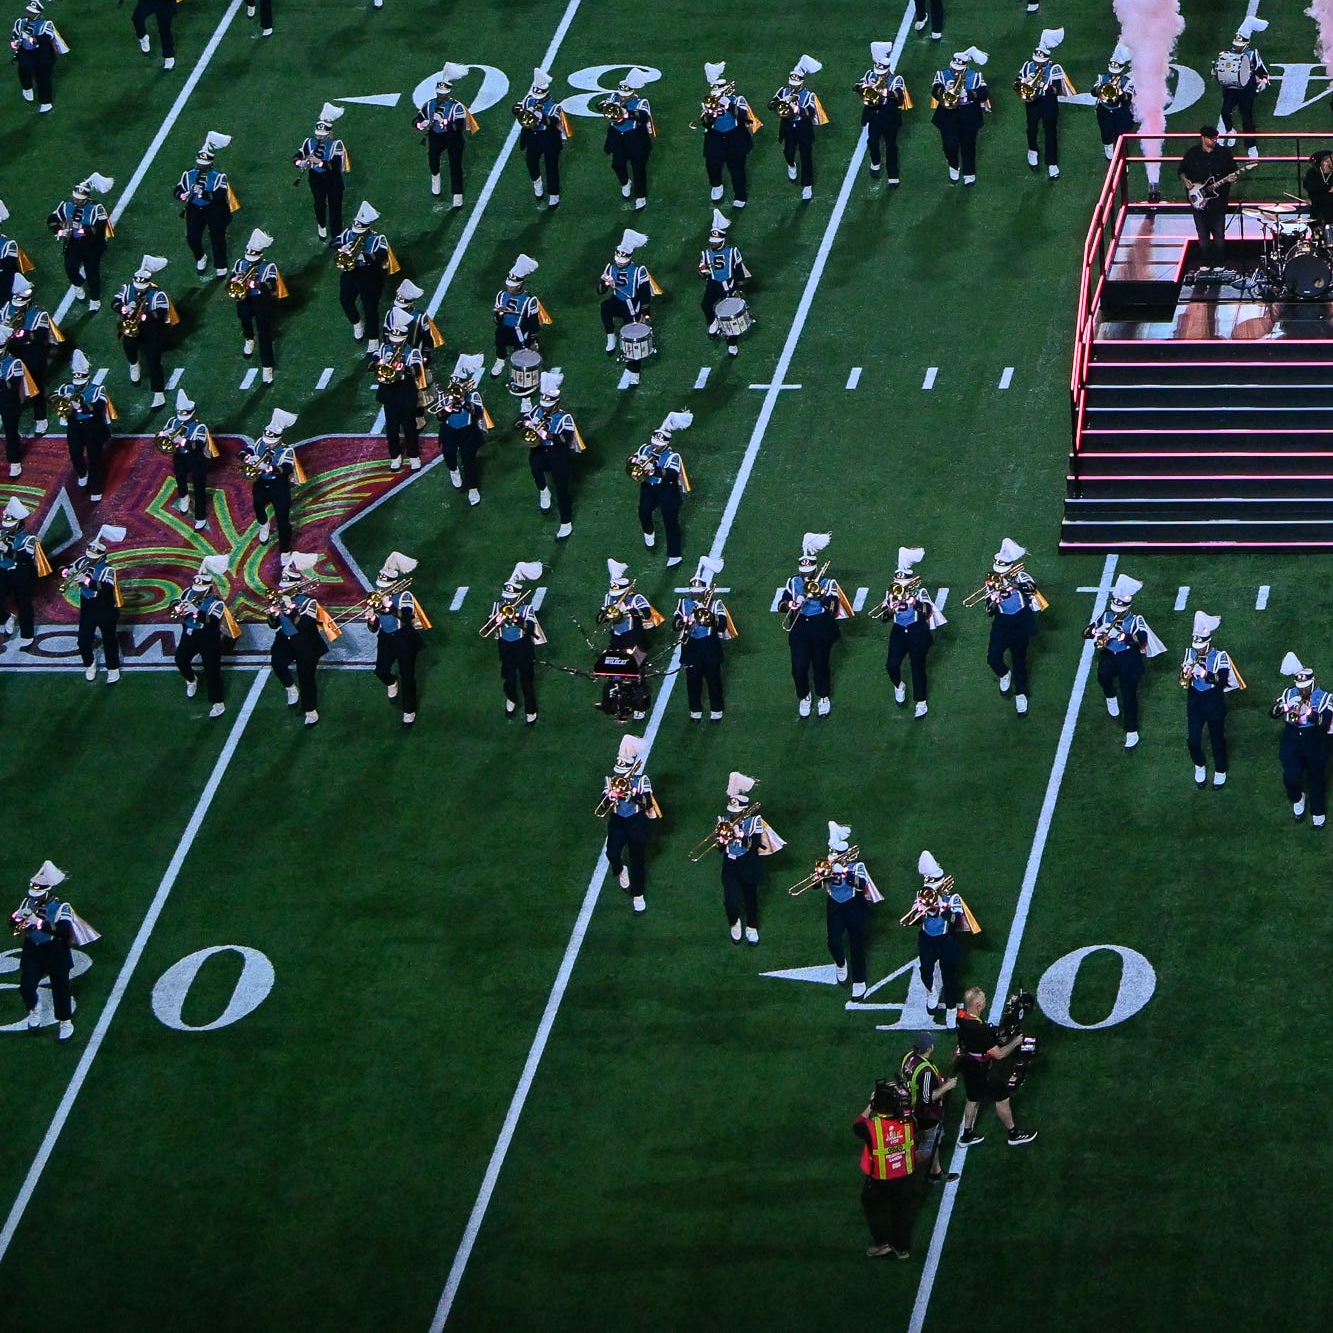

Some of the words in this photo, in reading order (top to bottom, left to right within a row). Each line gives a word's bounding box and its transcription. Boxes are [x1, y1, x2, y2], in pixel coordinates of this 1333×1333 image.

[714, 255, 726, 270] S
[616, 272, 628, 286] S
[508, 299, 519, 314] S
